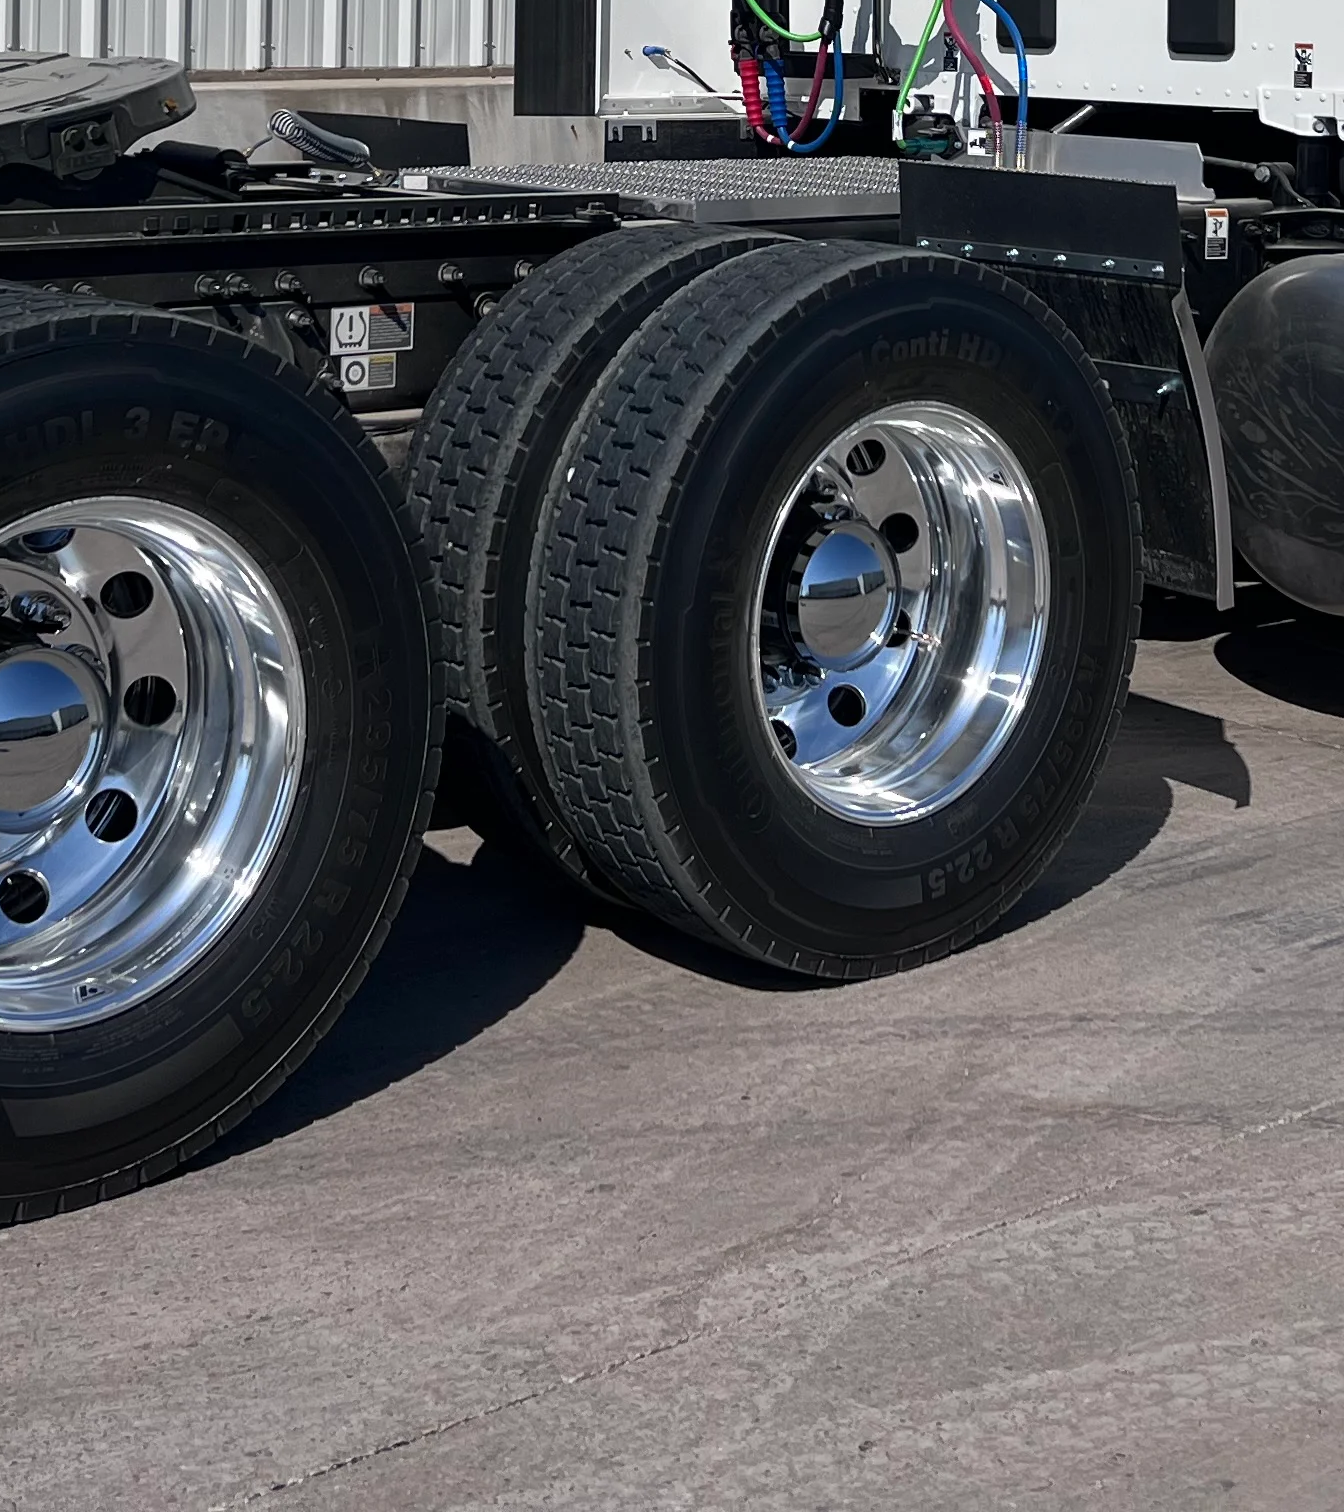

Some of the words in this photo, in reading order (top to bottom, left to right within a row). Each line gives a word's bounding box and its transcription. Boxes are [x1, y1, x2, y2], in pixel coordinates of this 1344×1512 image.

[870, 327, 950, 372] Conti
[122, 405, 151, 440] 3
[337, 688, 393, 868] 295/75
[927, 839, 993, 900] 22.5
[241, 920, 324, 1028] 22.5
